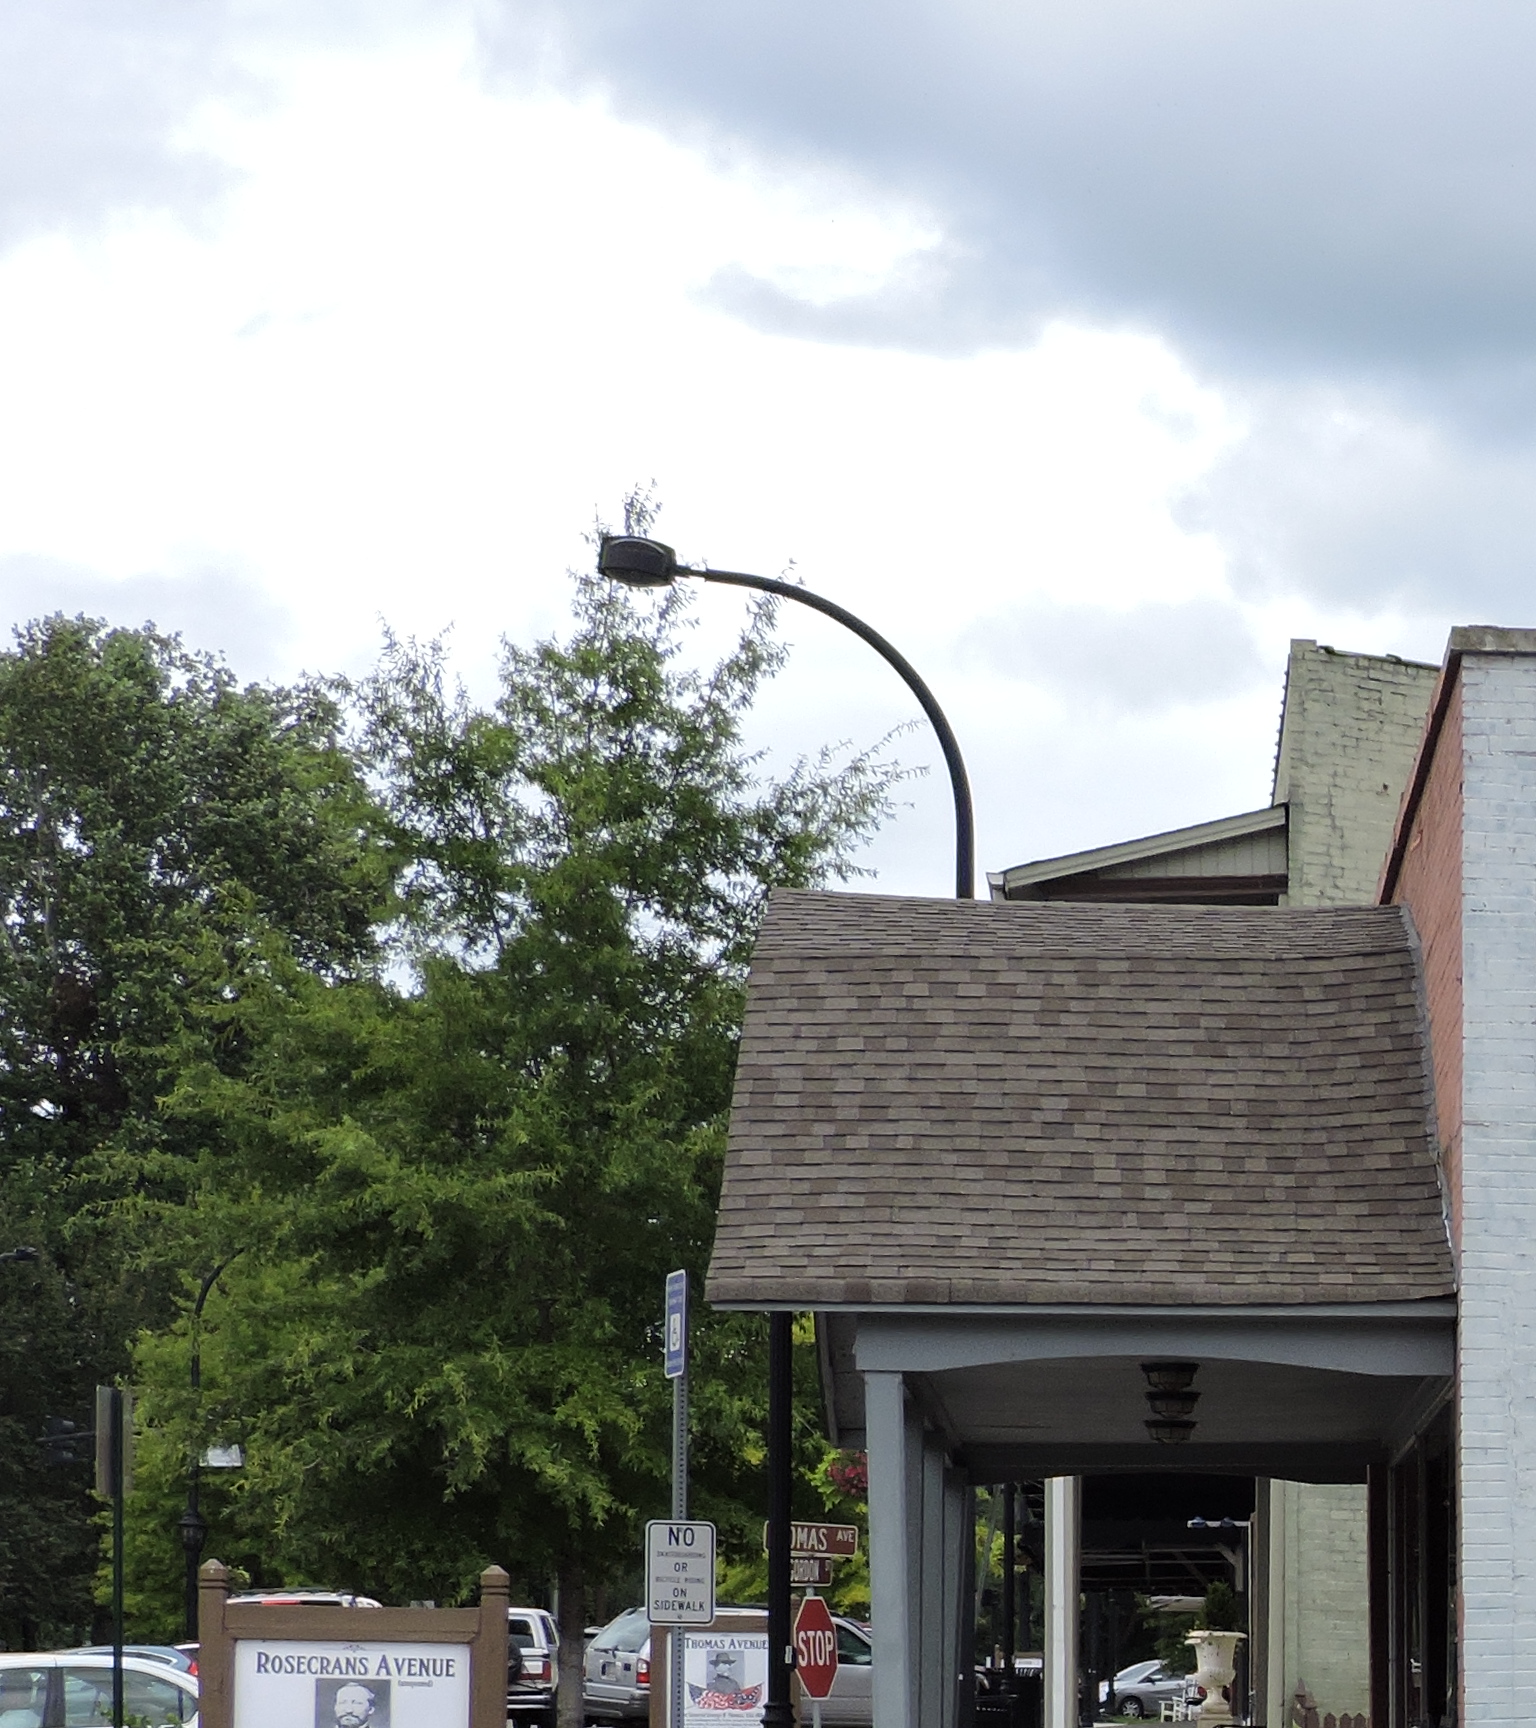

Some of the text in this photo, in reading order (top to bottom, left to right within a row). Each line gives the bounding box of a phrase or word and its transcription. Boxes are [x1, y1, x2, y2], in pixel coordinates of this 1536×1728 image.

[668, 1526, 695, 1547] NO
[836, 1529, 855, 1543] AVE
[673, 1562, 688, 1573] OR
[672, 1587, 688, 1598] ON
[653, 1599, 705, 1612] SIDEWALK
[685, 1637, 769, 1650] THOMAS AVENUE
[798, 1630, 835, 1667] STOP
[256, 1651, 456, 1677] ROSECRANS AVENUE
